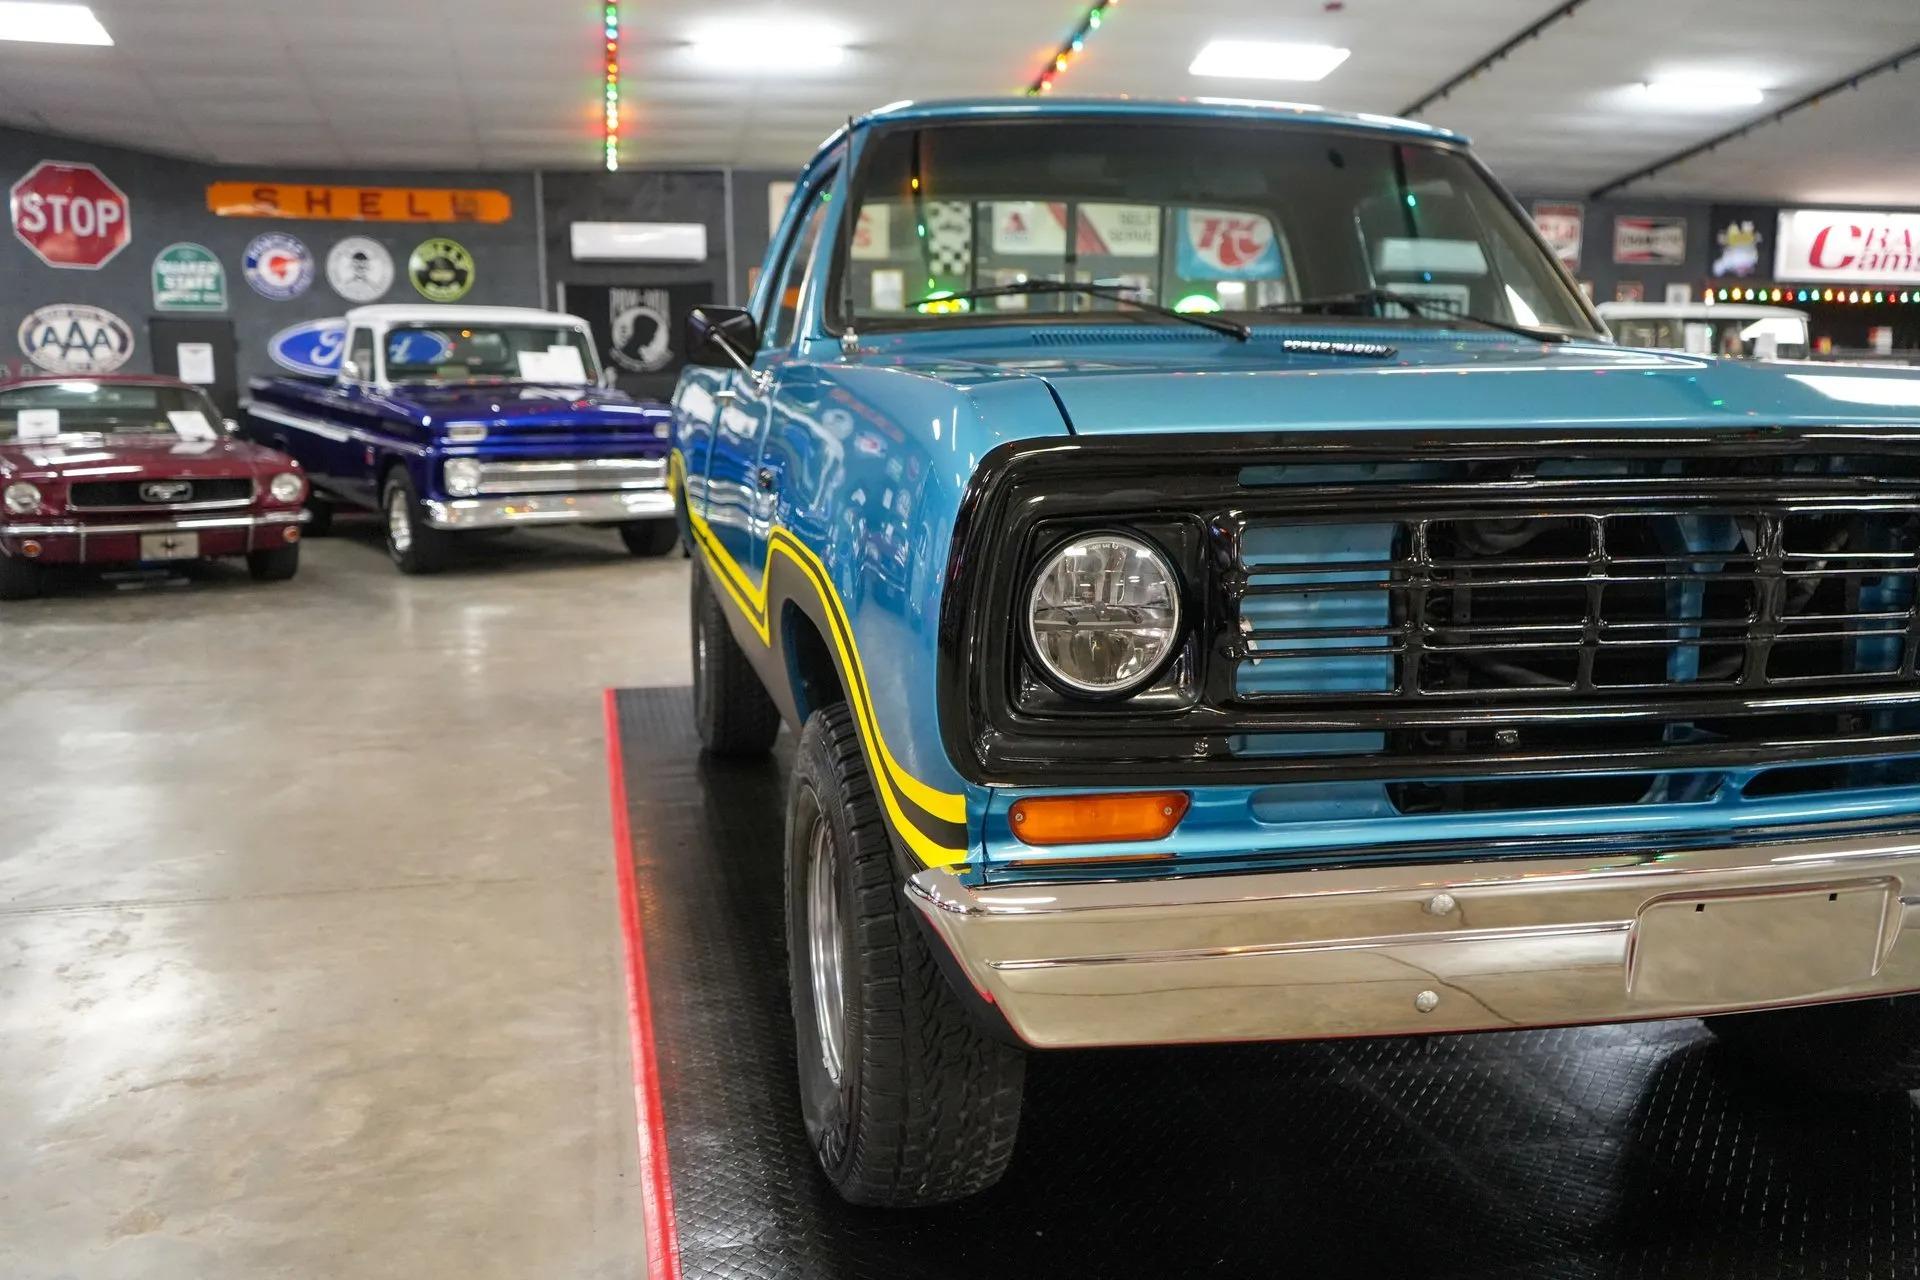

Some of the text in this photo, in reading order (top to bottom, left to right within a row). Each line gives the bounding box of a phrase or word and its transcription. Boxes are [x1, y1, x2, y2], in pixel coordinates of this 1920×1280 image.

[21, 193, 121, 237] STOP
[252, 188, 473, 219] SHELL
[164, 275, 216, 290] STATE
[41, 321, 112, 360] AAA
